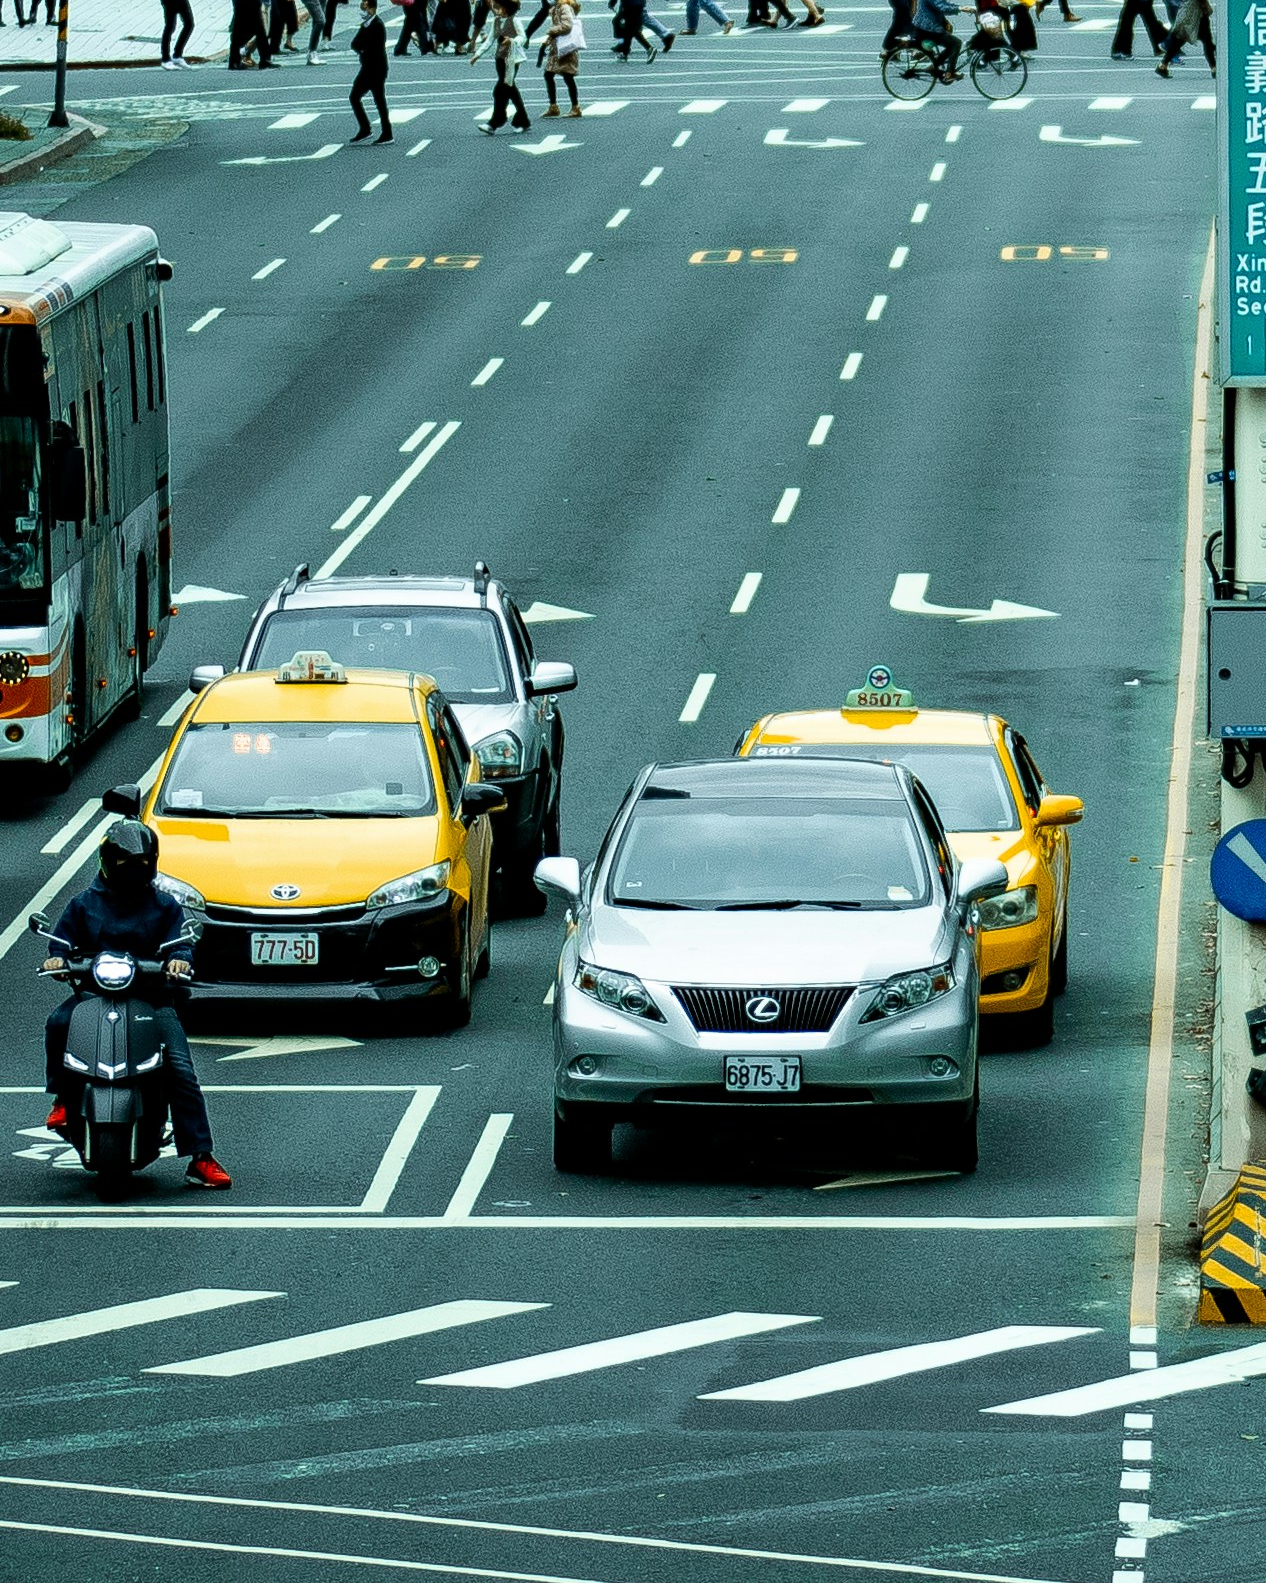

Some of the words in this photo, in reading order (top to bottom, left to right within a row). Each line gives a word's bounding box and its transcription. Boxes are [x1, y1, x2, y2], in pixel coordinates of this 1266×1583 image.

[1235, 275, 1266, 294] Rd.
[1247, 335, 1252, 356] 1
[857, 693, 903, 707] 8507
[756, 746, 802, 756] 8507
[254, 939, 316, 960] 777-5D
[727, 1064, 799, 1086] 6875-J7
